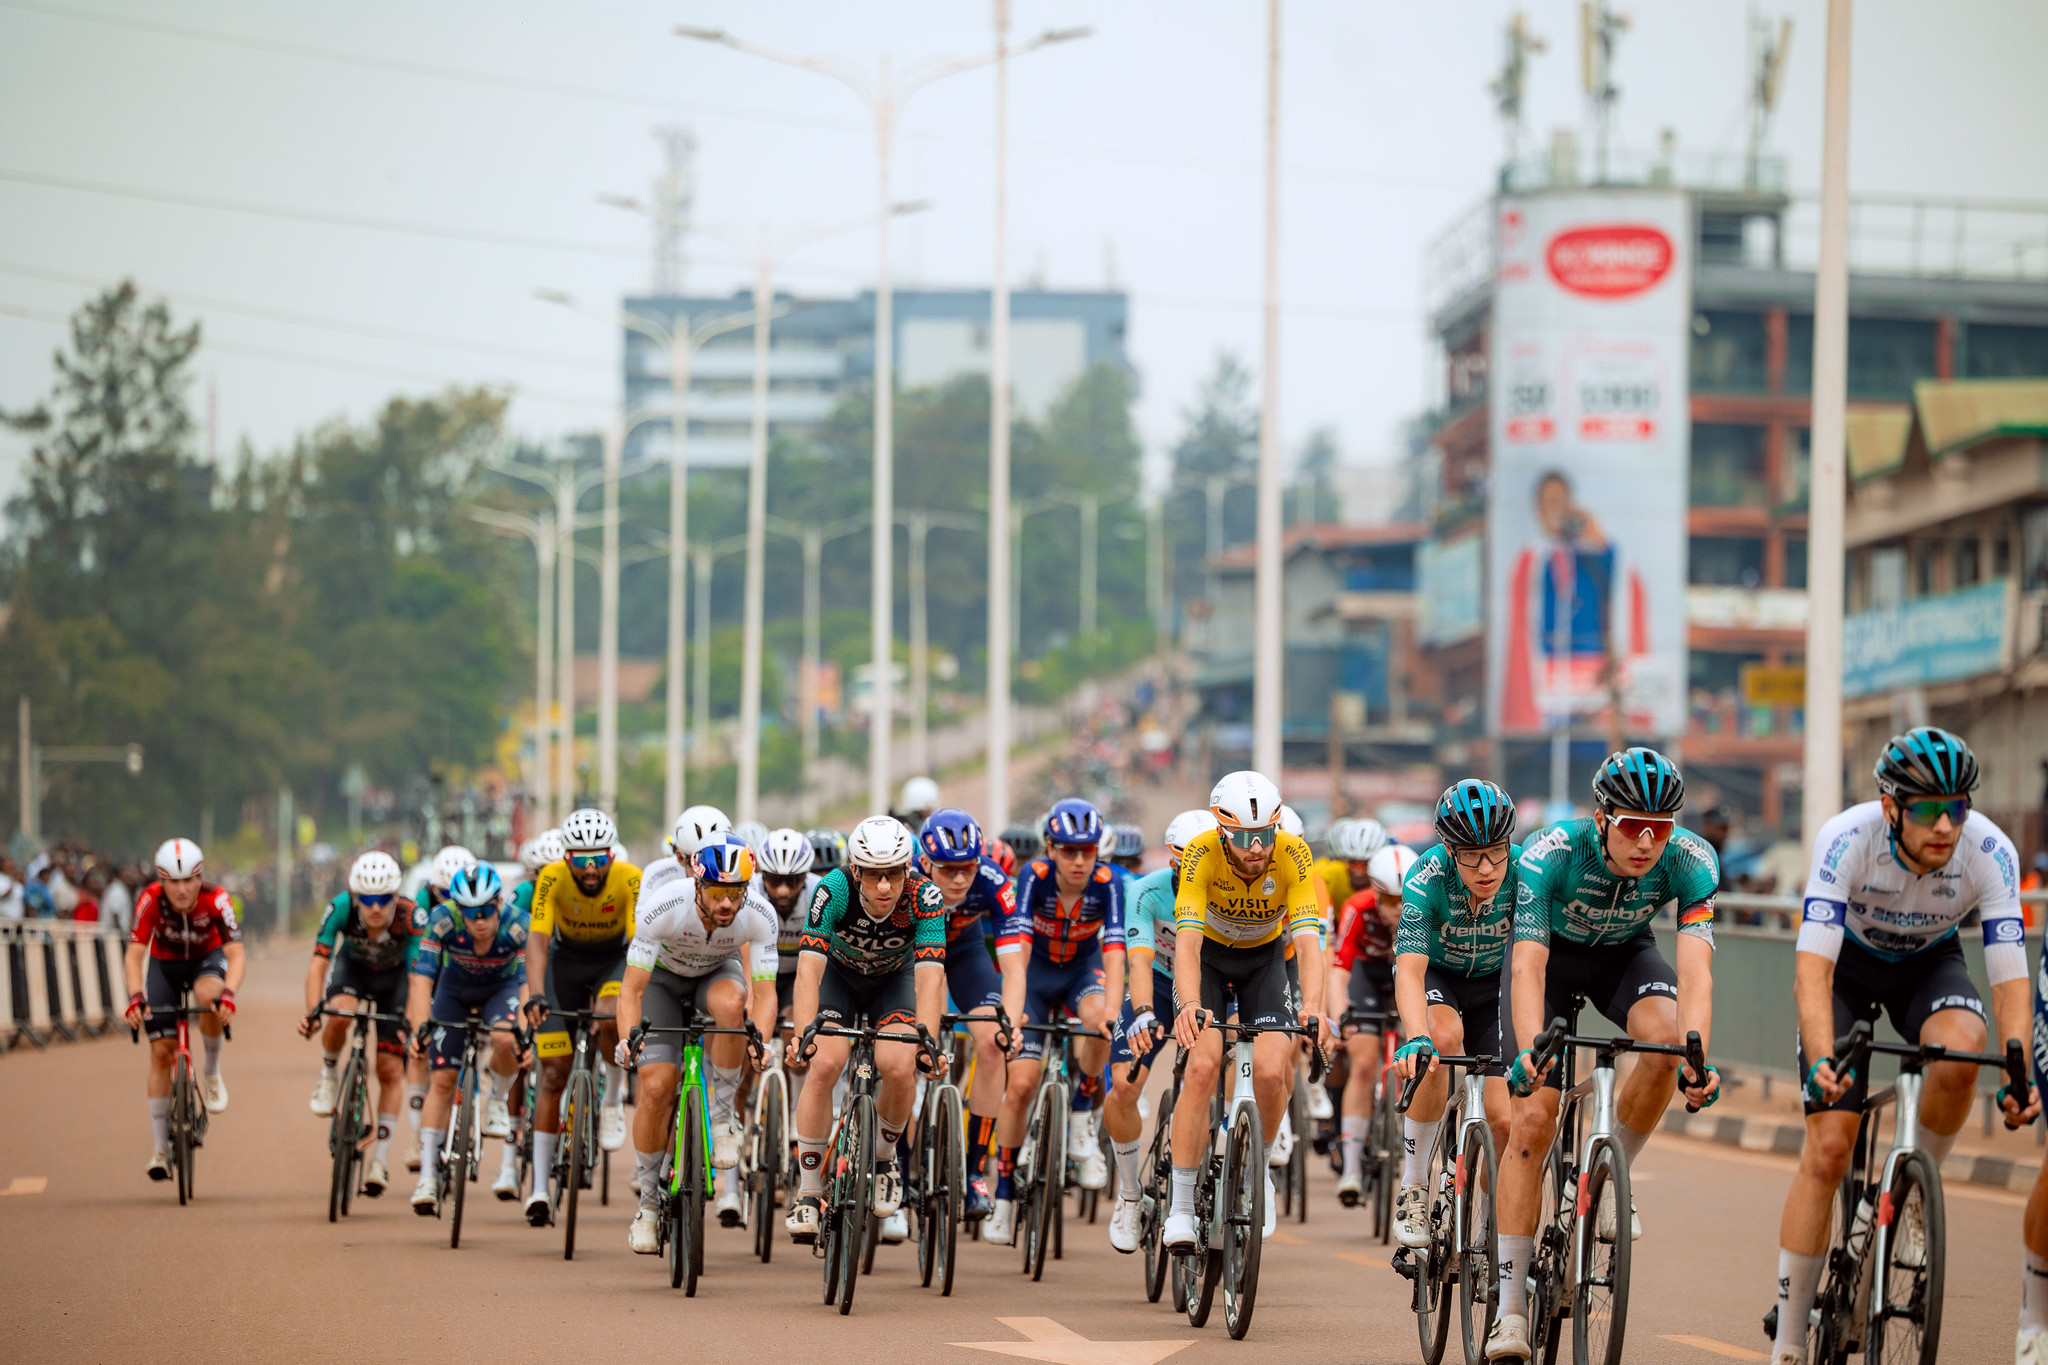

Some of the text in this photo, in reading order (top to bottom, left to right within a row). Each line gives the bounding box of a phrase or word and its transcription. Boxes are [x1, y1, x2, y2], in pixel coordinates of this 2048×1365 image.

[1183, 843, 1197, 869] VISIT
[1298, 843, 1312, 868] VISIT
[1669, 834, 1719, 884] LAPIERRE
[1824, 827, 1860, 866] SENSITIVE
[1186, 845, 1210, 882] RWANDA
[1285, 845, 1307, 883] RWANDA
[644, 896, 684, 925] SHIMANO
[1210, 901, 1285, 919] RWANDA
[1228, 898, 1269, 909] VISIT
[1290, 910, 1318, 919] RWAND
[1873, 906, 1961, 920] SENSITIV
[745, 900, 777, 934] SHIMANO
[1872, 914, 1938, 927] GROUP
[836, 930, 905, 950] HYLO
